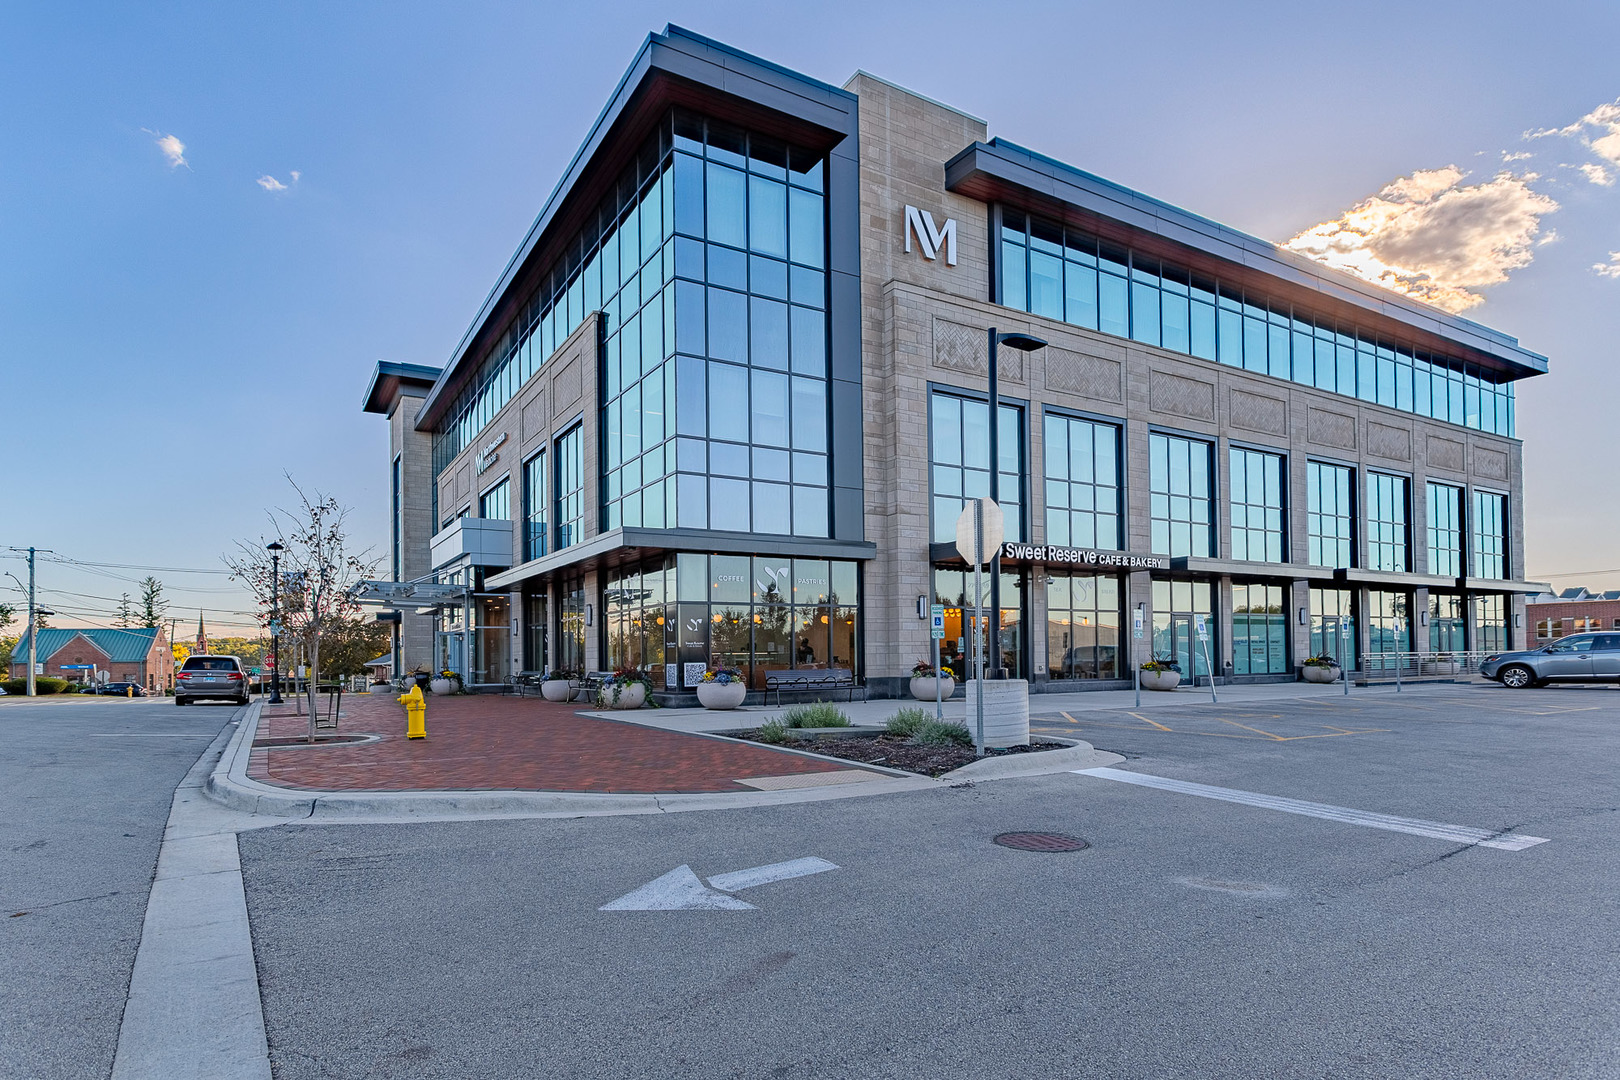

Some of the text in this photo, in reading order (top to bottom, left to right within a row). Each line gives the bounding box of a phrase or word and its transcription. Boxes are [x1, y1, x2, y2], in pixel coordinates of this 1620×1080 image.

[1005, 542, 1163, 569] Sweet Reserve CAFE & BAKERY
[718, 575, 744, 583] COFFEE
[798, 578, 827, 586] PASTRIES
